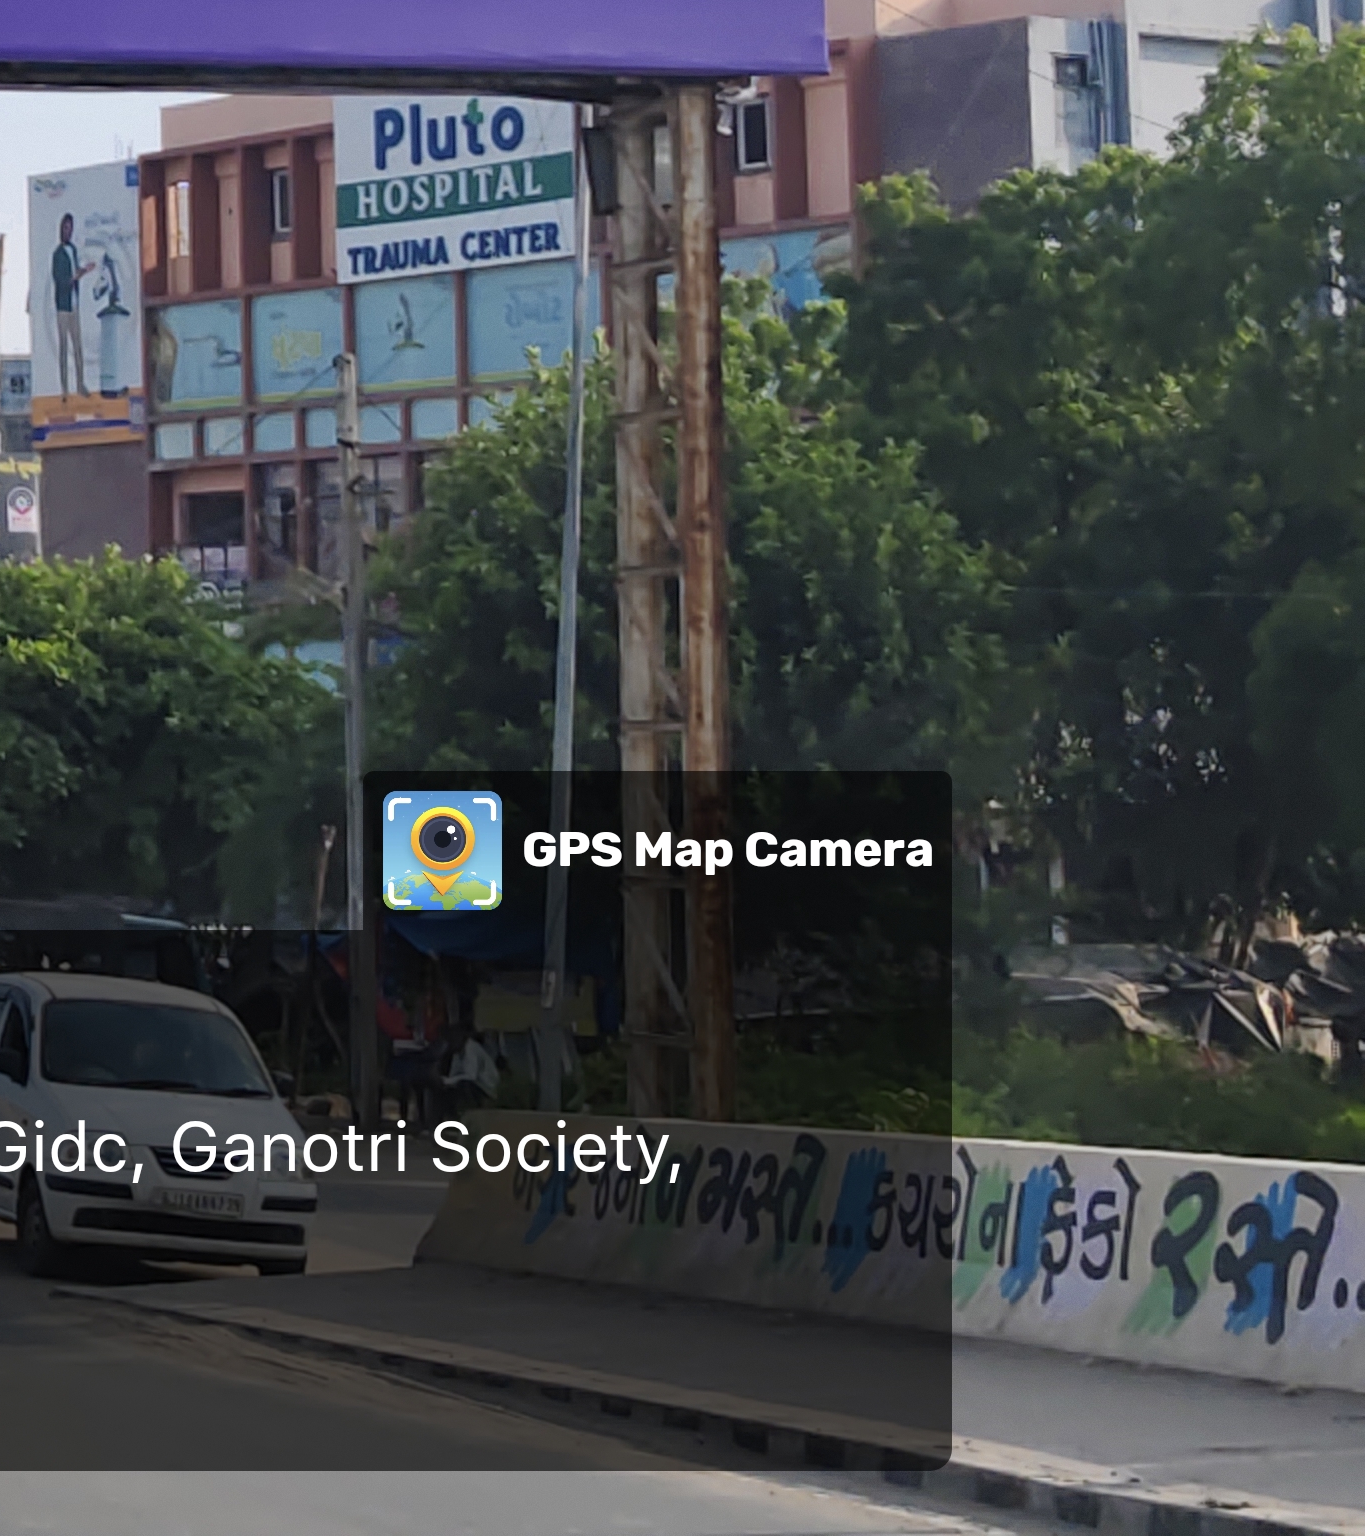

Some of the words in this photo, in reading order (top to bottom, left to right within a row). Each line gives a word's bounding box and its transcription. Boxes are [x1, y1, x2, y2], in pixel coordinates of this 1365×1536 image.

[373, 98, 525, 170] Pluto
[356, 161, 544, 220] HOSPITAL
[346, 235, 451, 276] TRAUMA
[459, 221, 562, 262] CENTER
